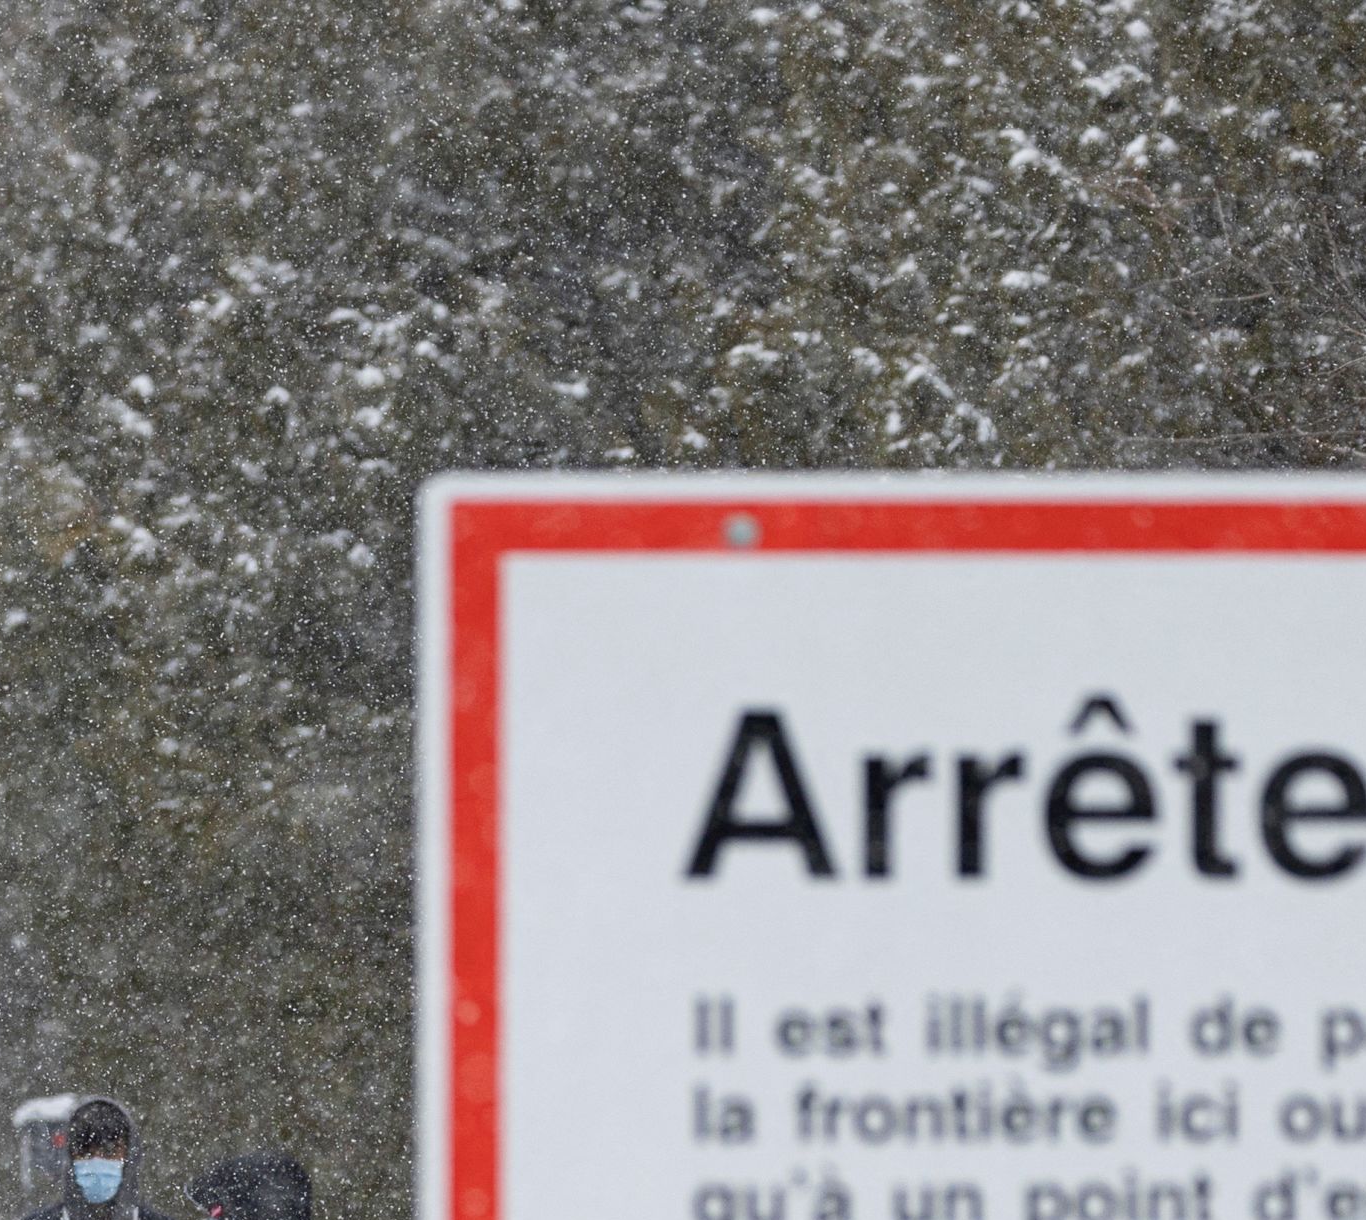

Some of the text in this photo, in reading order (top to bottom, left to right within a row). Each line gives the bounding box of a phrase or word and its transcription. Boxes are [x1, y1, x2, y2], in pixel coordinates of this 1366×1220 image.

[692, 998, 737, 1055] Il
[773, 1000, 887, 1057] est
[924, 993, 1151, 1073] illégal
[1189, 998, 1283, 1057] de
[692, 1085, 756, 1144] la
[794, 1081, 1118, 1144] frontière
[1155, 1083, 1242, 1144] ici
